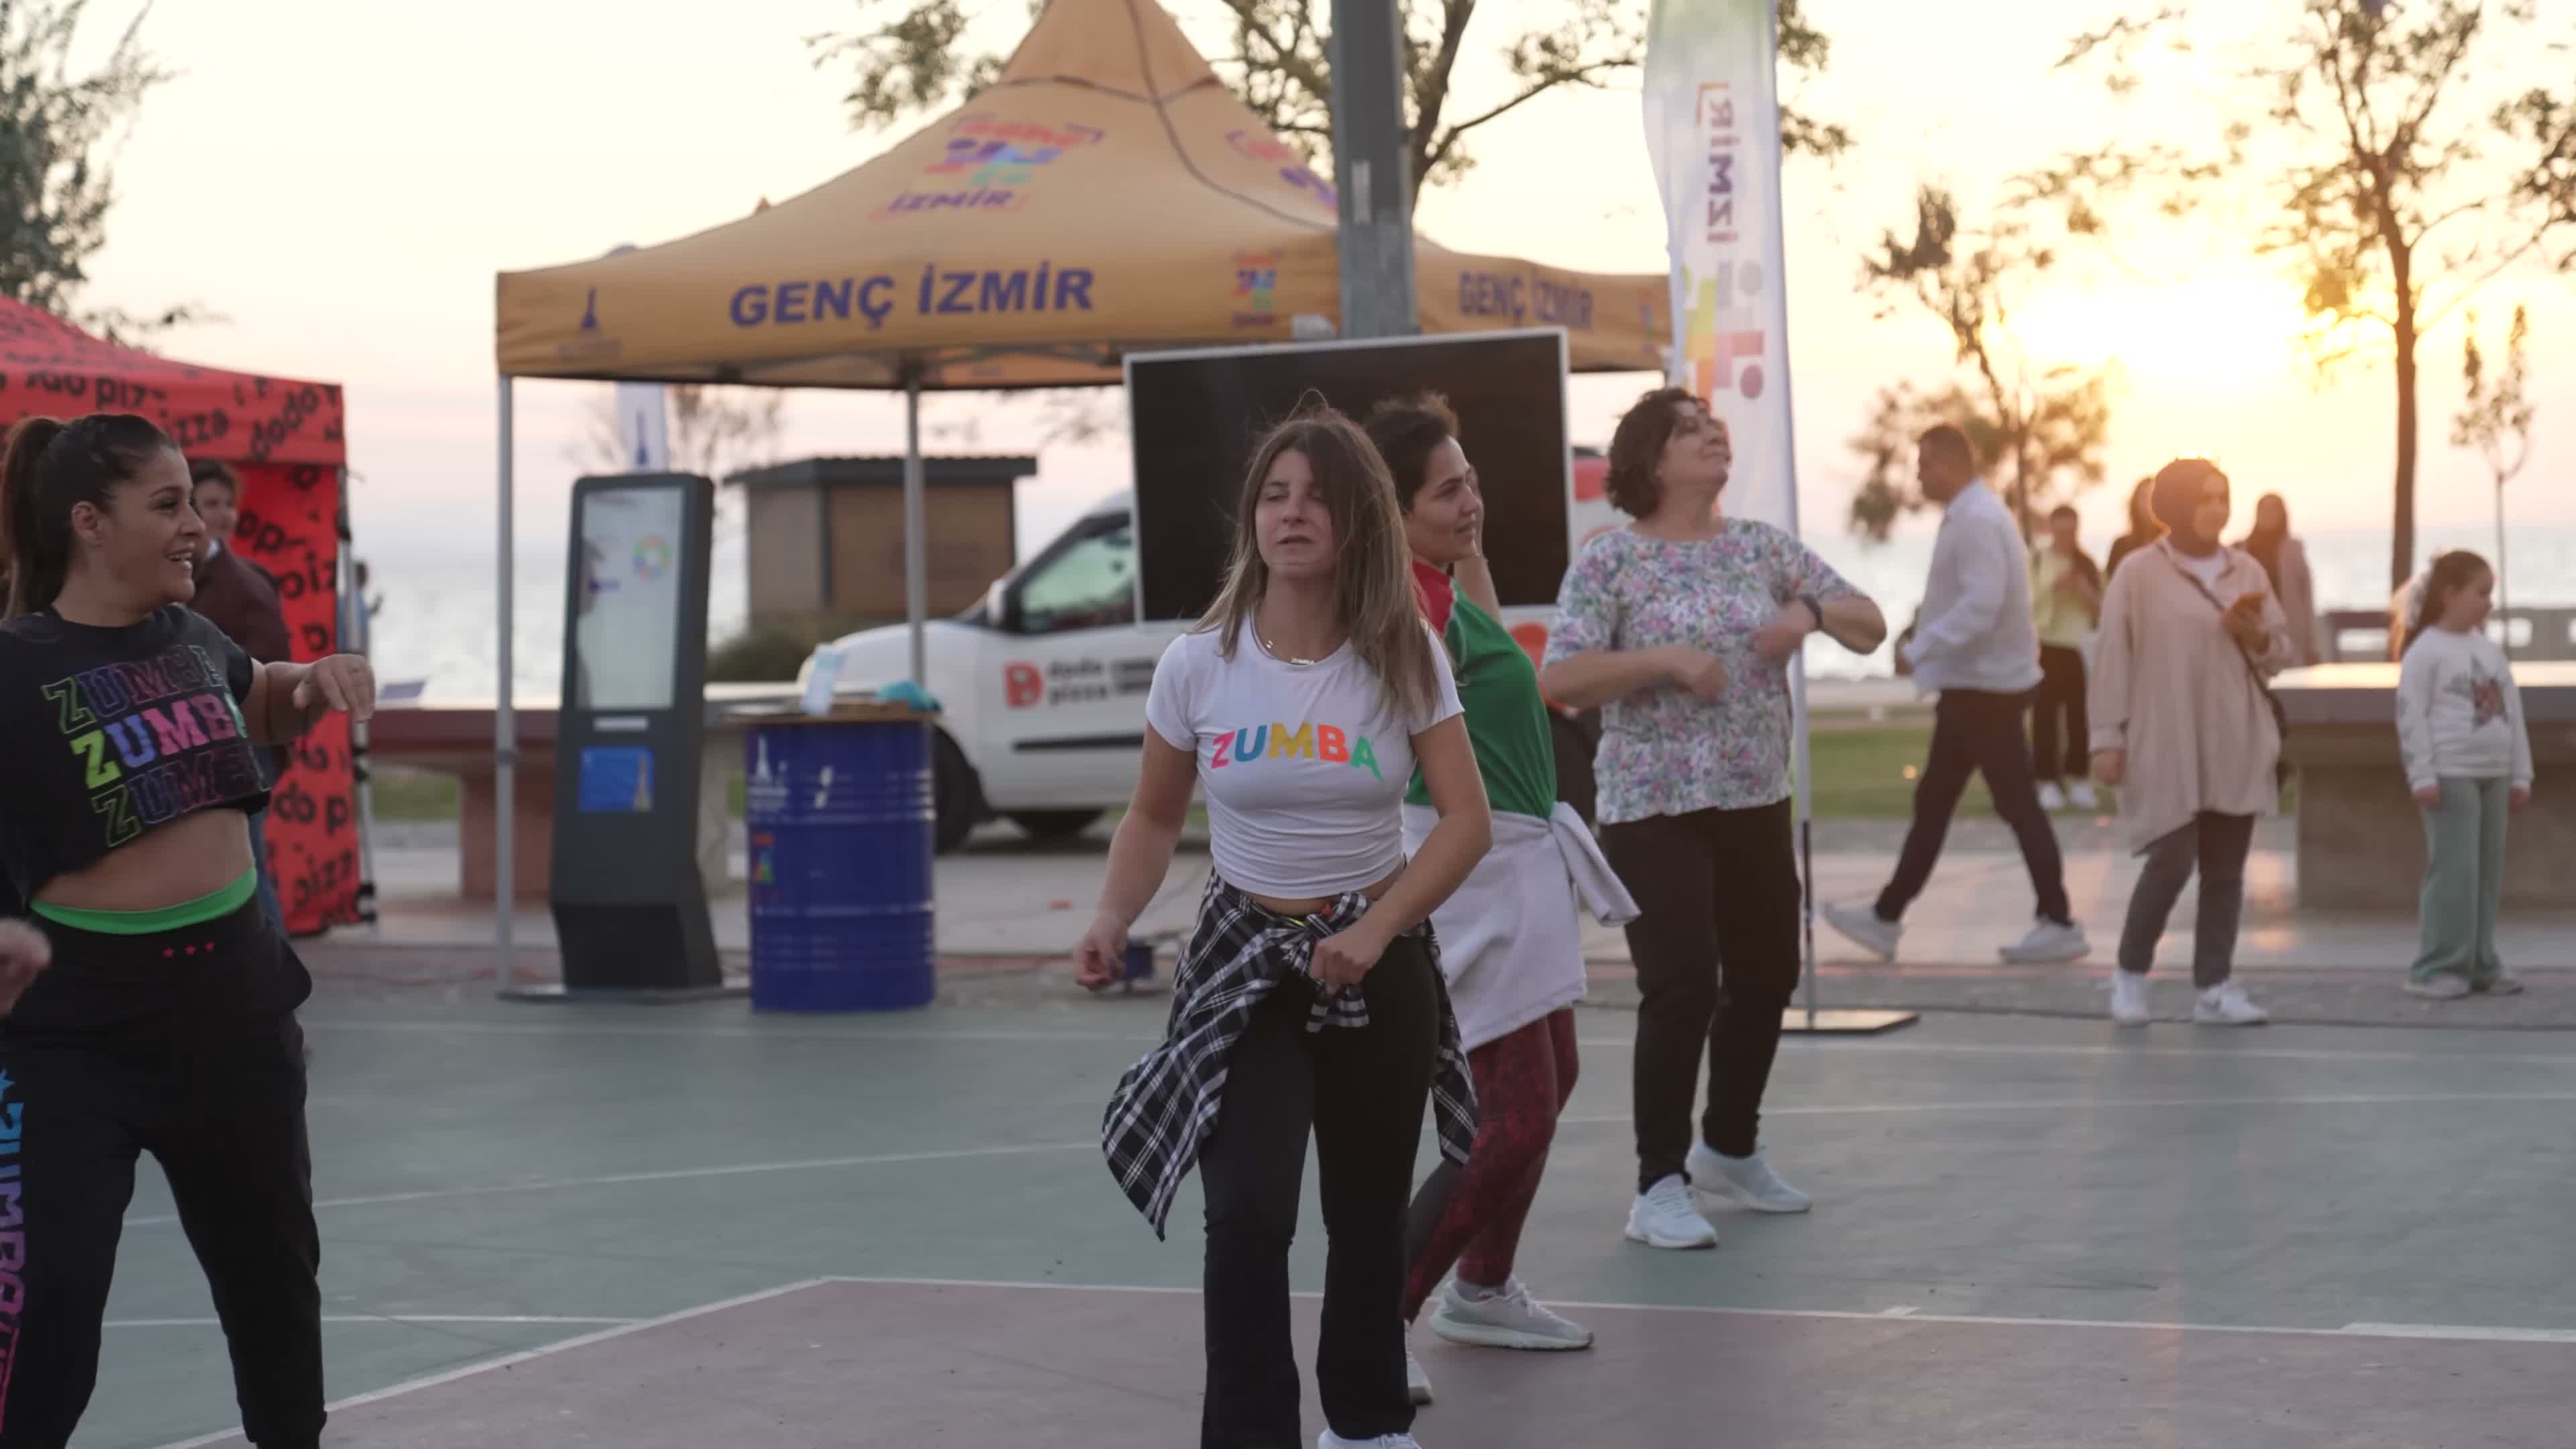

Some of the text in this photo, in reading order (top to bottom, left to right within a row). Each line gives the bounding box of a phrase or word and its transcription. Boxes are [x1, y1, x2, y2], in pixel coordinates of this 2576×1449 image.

[729, 260, 1095, 331] GENÇ İZMİR
[1210, 721, 1384, 784] ZUMBA
